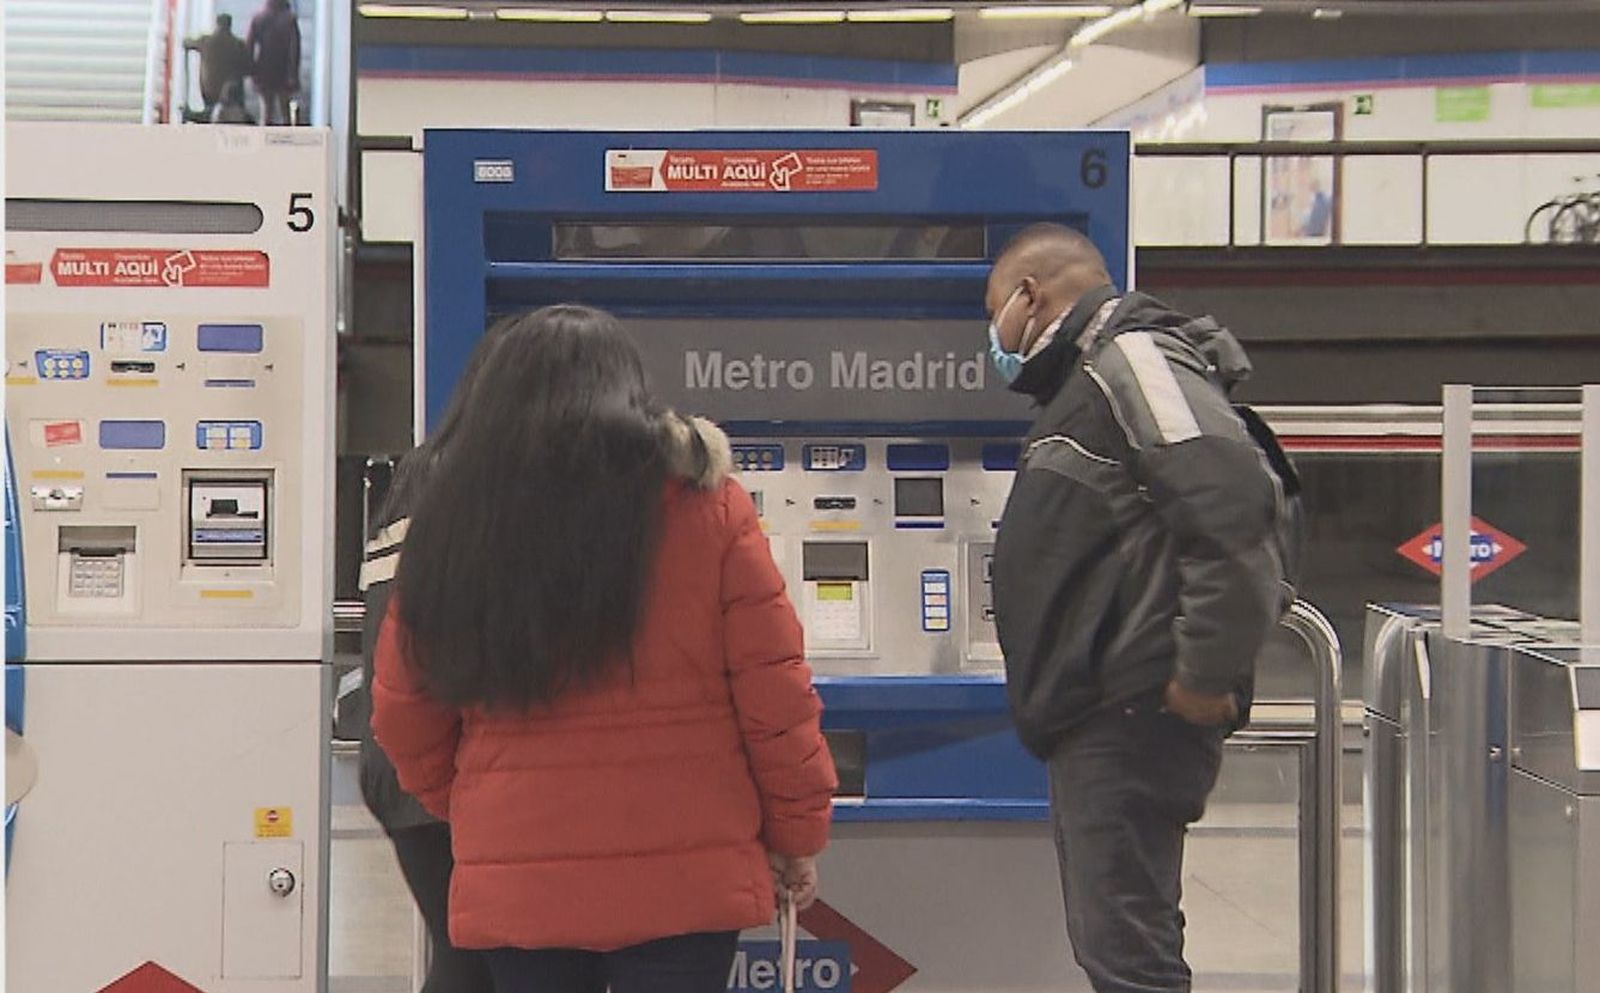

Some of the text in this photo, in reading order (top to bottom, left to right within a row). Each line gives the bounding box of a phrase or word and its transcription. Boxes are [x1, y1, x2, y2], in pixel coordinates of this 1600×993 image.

[667, 161, 767, 181] MULTI AQUÍ
[1080, 148, 1107, 190] 6
[286, 192, 315, 232] 5
[57, 261, 110, 276] MULTI
[684, 350, 986, 390] Metro Madrid
